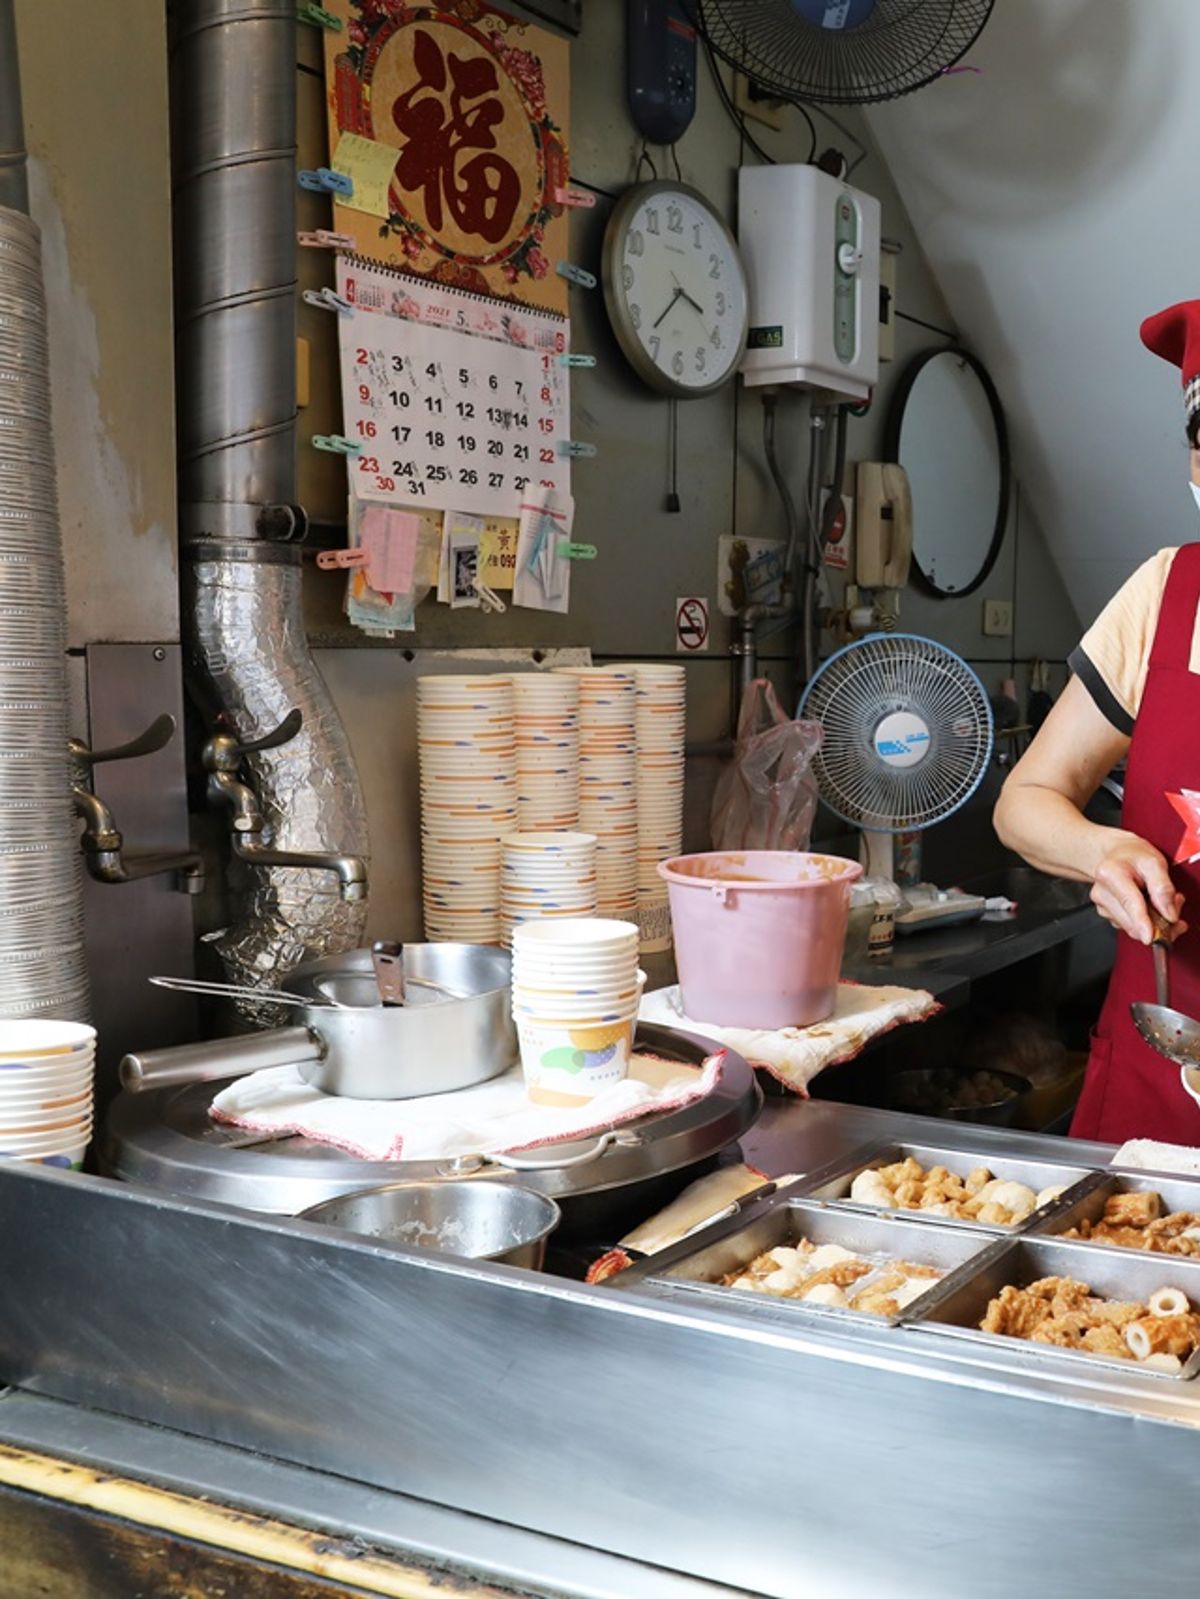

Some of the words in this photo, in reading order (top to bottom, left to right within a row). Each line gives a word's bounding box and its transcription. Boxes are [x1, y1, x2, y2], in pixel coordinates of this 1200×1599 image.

[391, 29, 522, 245] 福
[645, 207, 660, 236] 11
[666, 205, 684, 235] 12
[627, 229, 645, 257] 10
[693, 223, 702, 249] 1
[709, 254, 721, 279] 2
[715, 291, 726, 316] 3
[649, 335, 661, 362] 7
[709, 325, 721, 350] 4
[541, 356, 549, 369] 1
[671, 351, 684, 376] 6
[695, 347, 706, 372] 5
[356, 348, 369, 365] 2
[392, 356, 404, 372] 3
[426, 363, 437, 378] 4
[459, 369, 469, 384] 5
[489, 375, 498, 390] 6
[515, 382, 524, 395] 7
[541, 387, 550, 401] 8
[359, 385, 370, 400] 9
[389, 391, 410, 407] 10
[425, 397, 443, 413] 11
[456, 402, 475, 418] 12
[486, 408, 502, 423] 13
[513, 413, 528, 427] 14
[538, 418, 554, 432] 15
[356, 420, 376, 437] 16
[392, 426, 411, 442] 17
[426, 432, 445, 447] 18
[457, 436, 476, 451] 19
[487, 440, 503, 456] 20
[514, 444, 529, 459] 21
[539, 449, 554, 463] 22
[358, 456, 379, 473] 23
[392, 461, 413, 477] 24
[426, 465, 447, 481] 25
[459, 469, 478, 485] 26
[489, 473, 504, 488] 27
[375, 475, 395, 491] 30
[408, 480, 426, 495] 31
